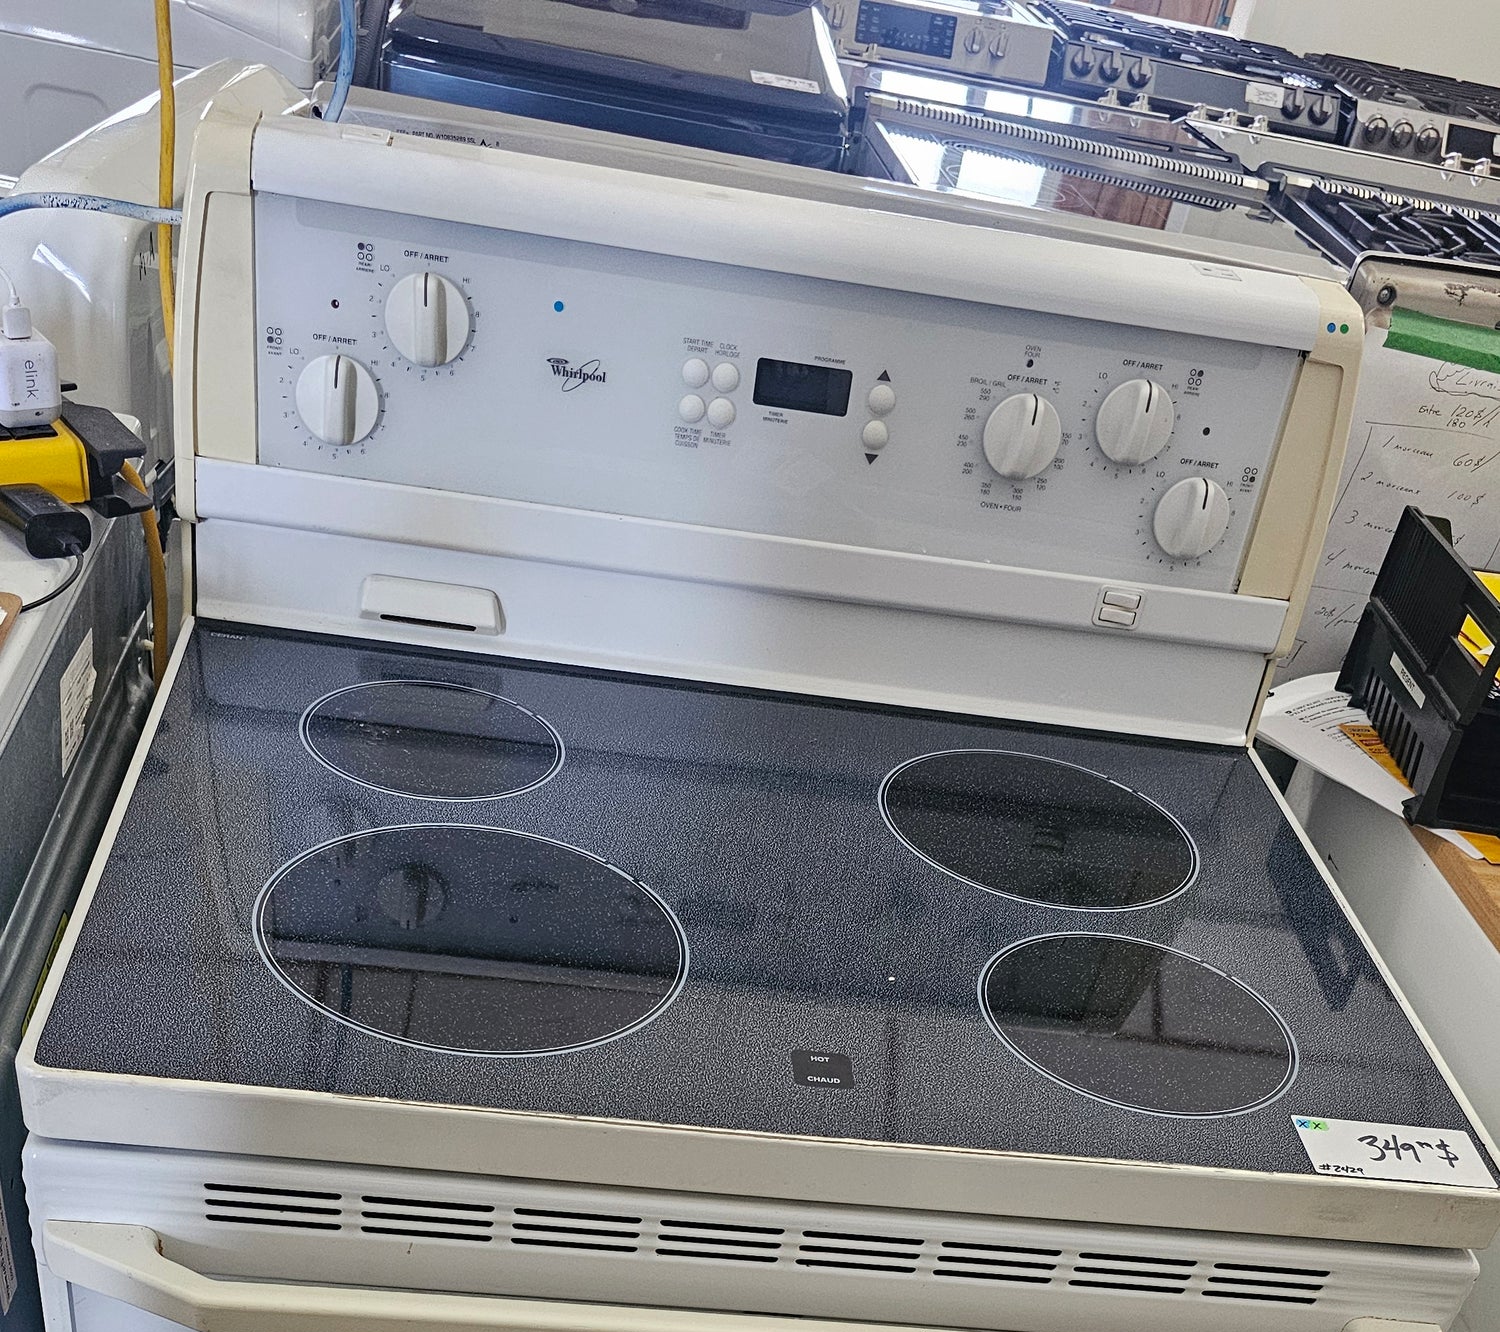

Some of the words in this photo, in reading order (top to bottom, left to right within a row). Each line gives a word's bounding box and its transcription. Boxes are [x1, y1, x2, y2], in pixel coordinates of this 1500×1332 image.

[404, 250, 419, 258] OFF
[424, 253, 450, 263] ARRET
[380, 264, 390, 272] LO
[313, 333, 327, 342] OFF
[332, 336, 357, 346] ARRET
[1025, 344, 1042, 352] OVEN
[1123, 359, 1136, 367] OFF
[1140, 362, 1163, 371] ARRET
[550, 364, 606, 384] Whirlpool
[1007, 374, 1020, 382] OFF
[1025, 376, 1048, 385] ARRET
[1456, 371, 1500, 392] Livrai
[1197, 460, 1219, 469] ARRET
[1360, 471, 1374, 481] 2
[980, 501, 998, 510] OVEN
[1003, 504, 1022, 512] FOUR
[1344, 509, 1359, 525] 3
[1325, 548, 1347, 567] 4
[810, 1055, 830, 1063] HOT
[807, 1075, 841, 1084] CHAUD
